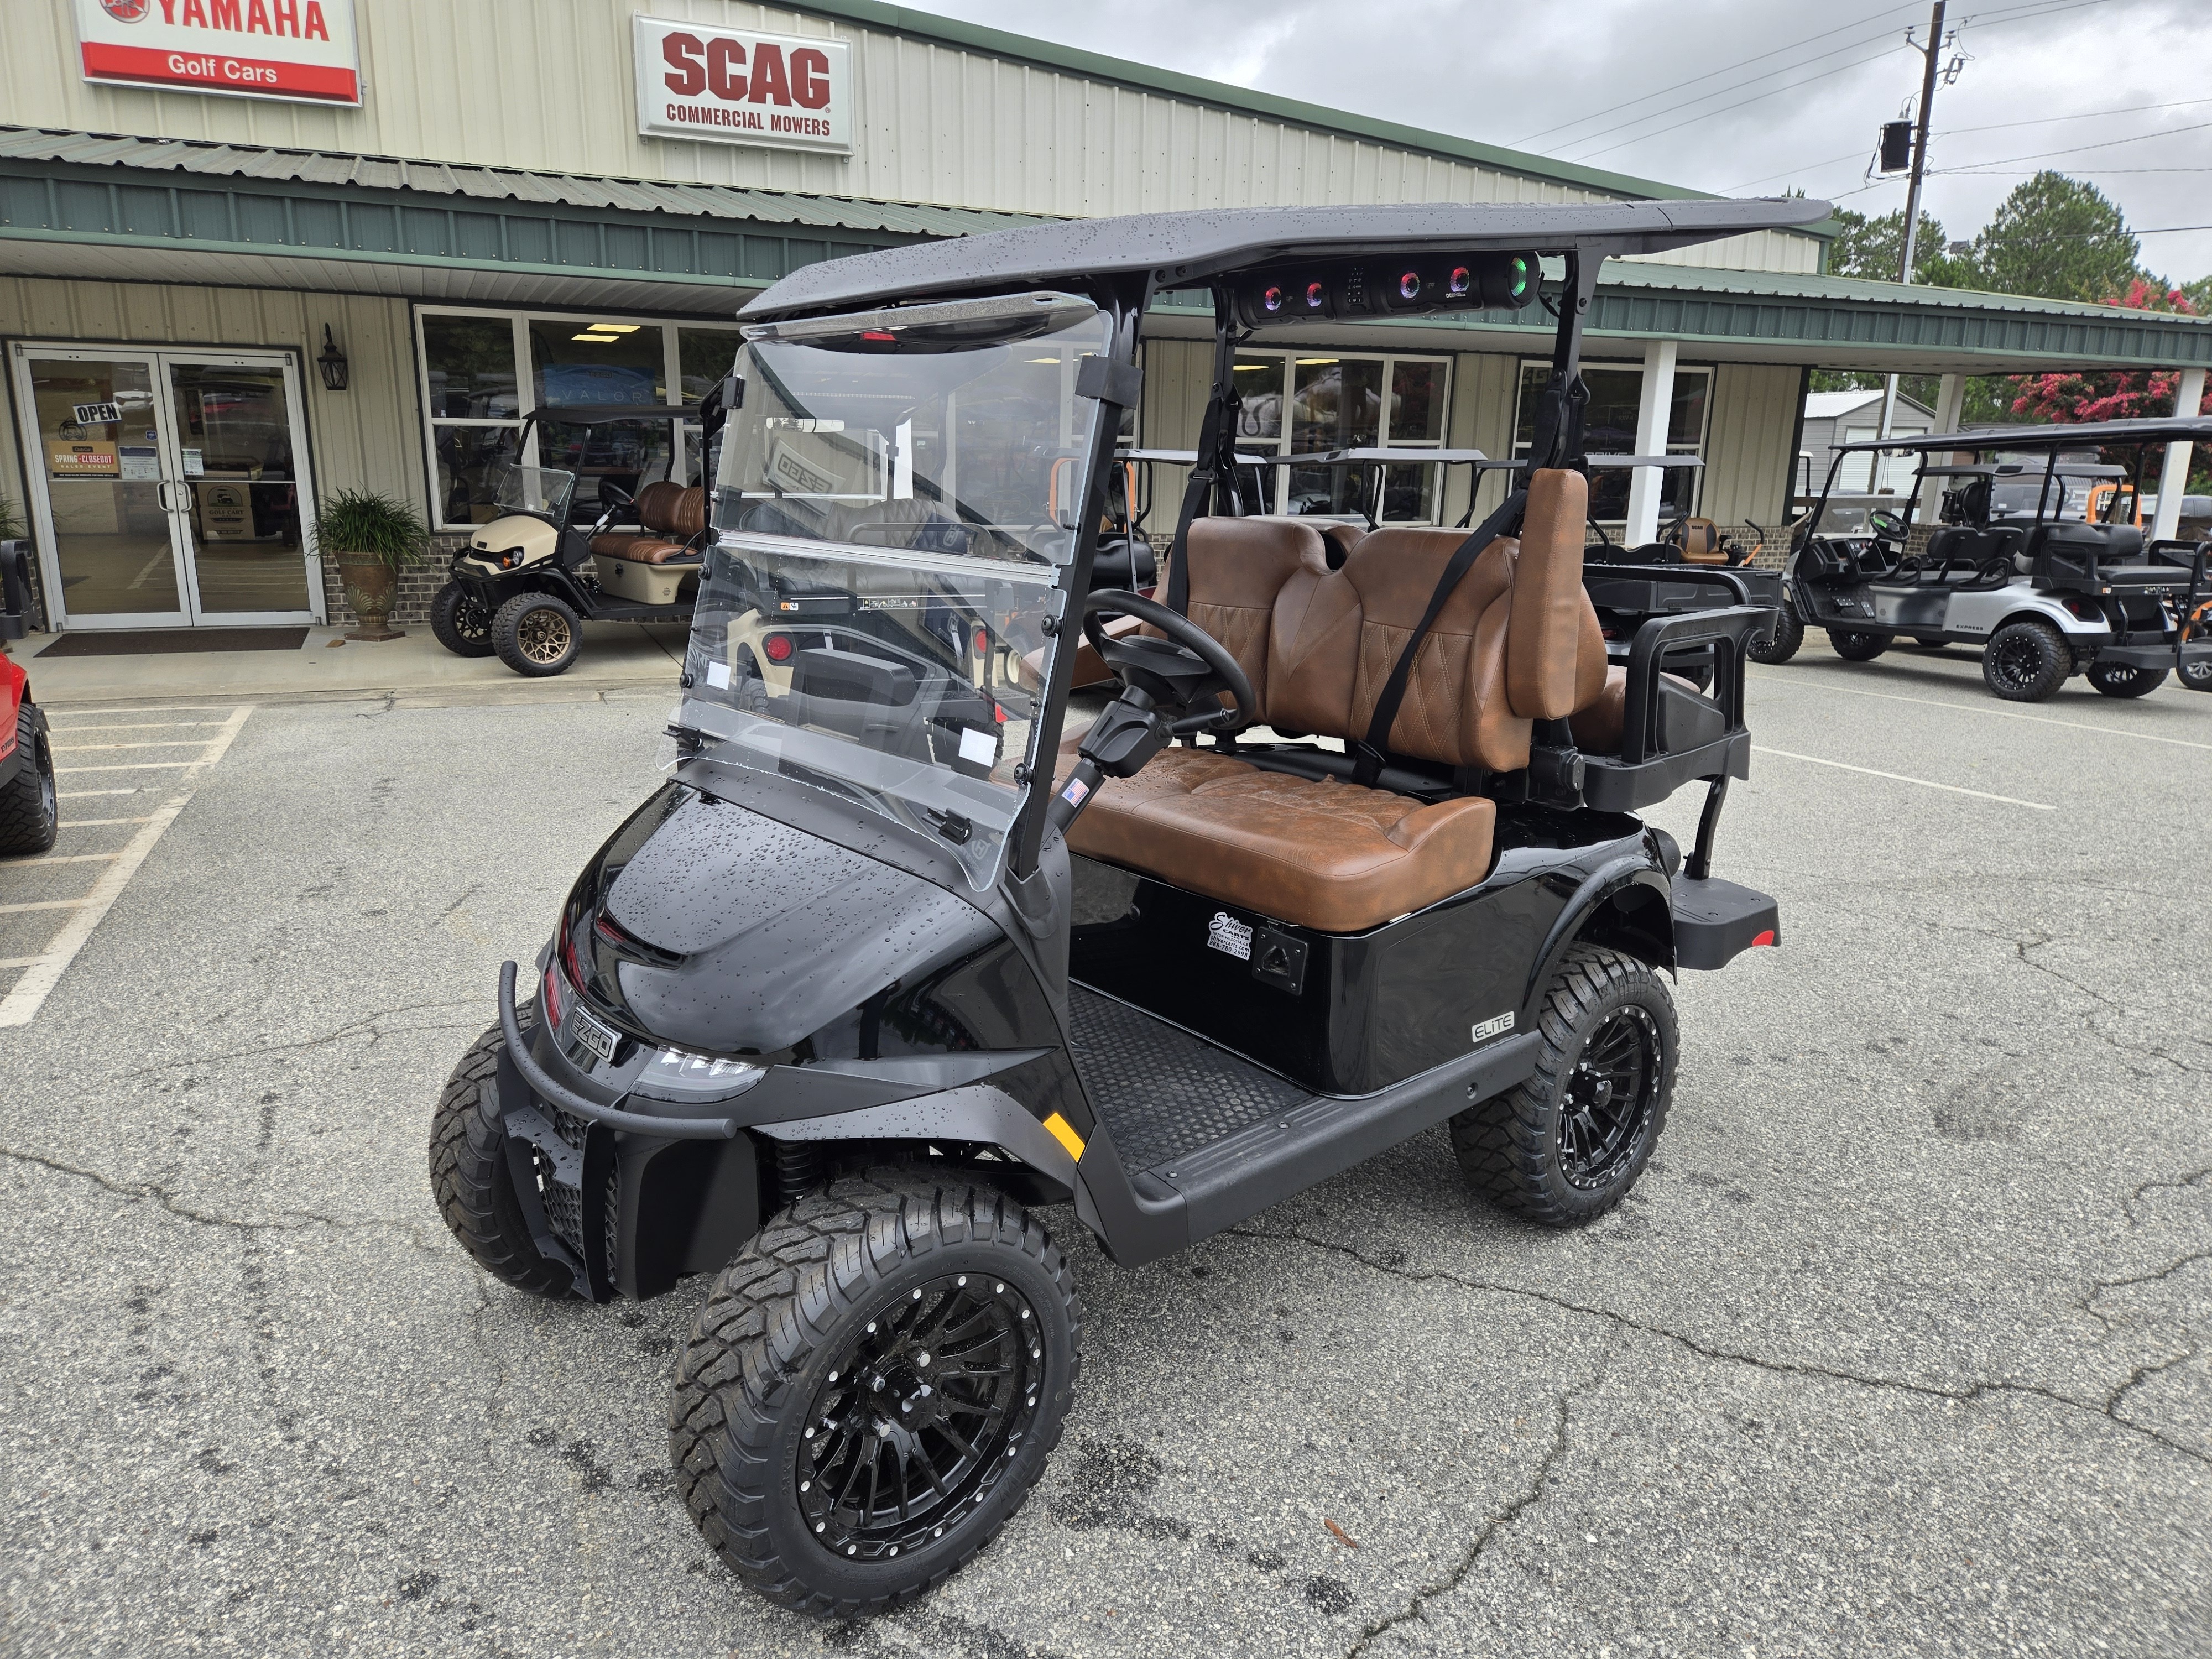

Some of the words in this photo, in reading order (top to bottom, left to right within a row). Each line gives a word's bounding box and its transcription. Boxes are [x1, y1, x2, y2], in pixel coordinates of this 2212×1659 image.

[157, 0, 330, 41] YAMAHA
[168, 55, 216, 77] Golf
[224, 60, 278, 83] Cars
[662, 32, 831, 110] SCAG
[666, 103, 764, 130] COMMERCIAL
[771, 114, 831, 137] MOWERS
[562, 389, 642, 402] VALOR
[77, 404, 119, 423] OPEN
[55, 455, 78, 463] SPRING
[81, 455, 112, 464] CLOSEOUT
[1210, 914, 1251, 934] Shiver
[1211, 935, 1250, 952] shivercarts.com
[1223, 929, 1250, 941] CARTS
[1209, 940, 1248, 958] 888-780-2998
[571, 1013, 612, 1057] EZGO
